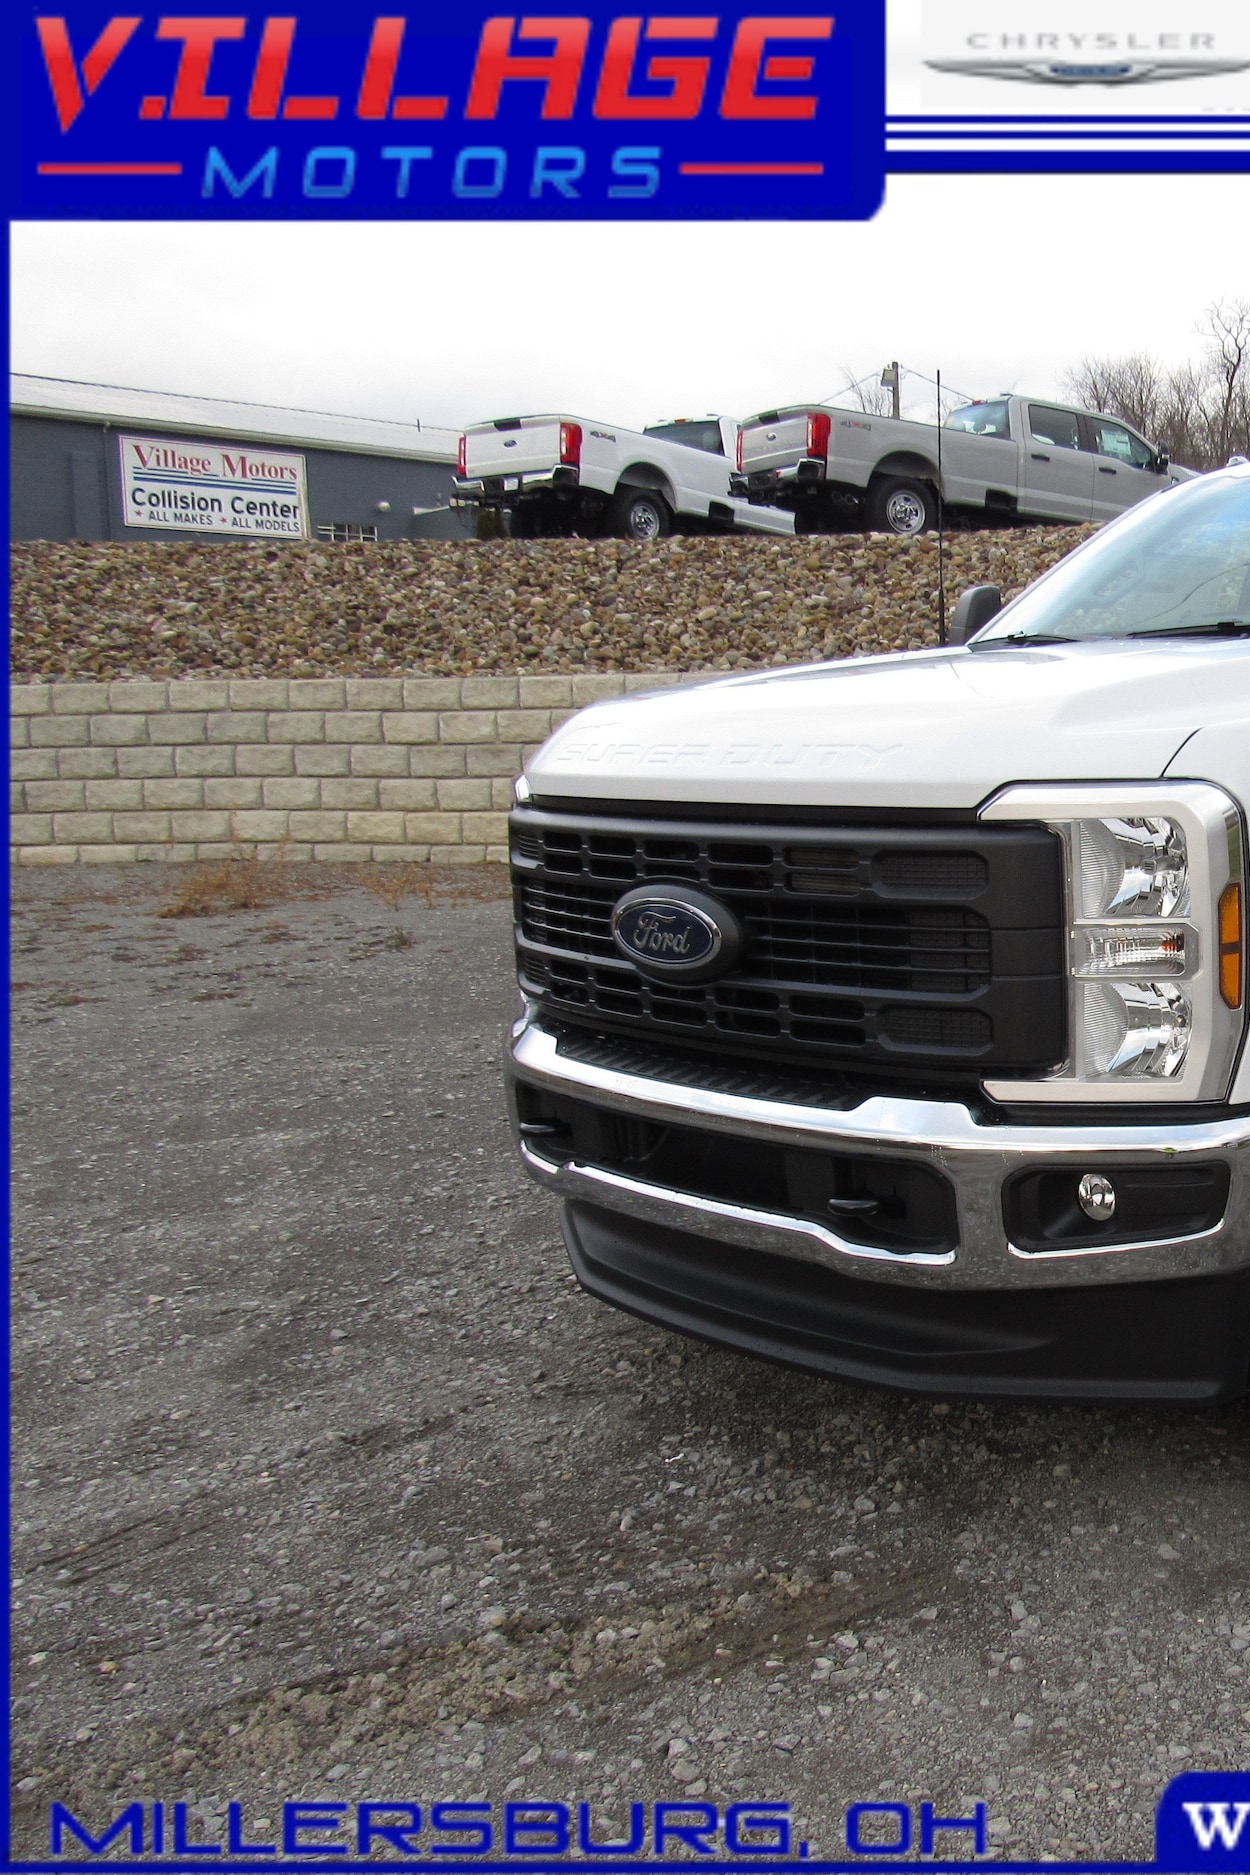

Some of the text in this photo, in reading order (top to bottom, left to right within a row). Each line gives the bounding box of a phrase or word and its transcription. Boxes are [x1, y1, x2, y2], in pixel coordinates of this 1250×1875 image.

[132, 444, 298, 480] Village Motors
[132, 488, 299, 519] Collision Center
[149, 510, 300, 533] ALL MAKES ALL MODELS
[556, 743, 905, 769] SUPER DUTY
[633, 911, 692, 954] Ford
